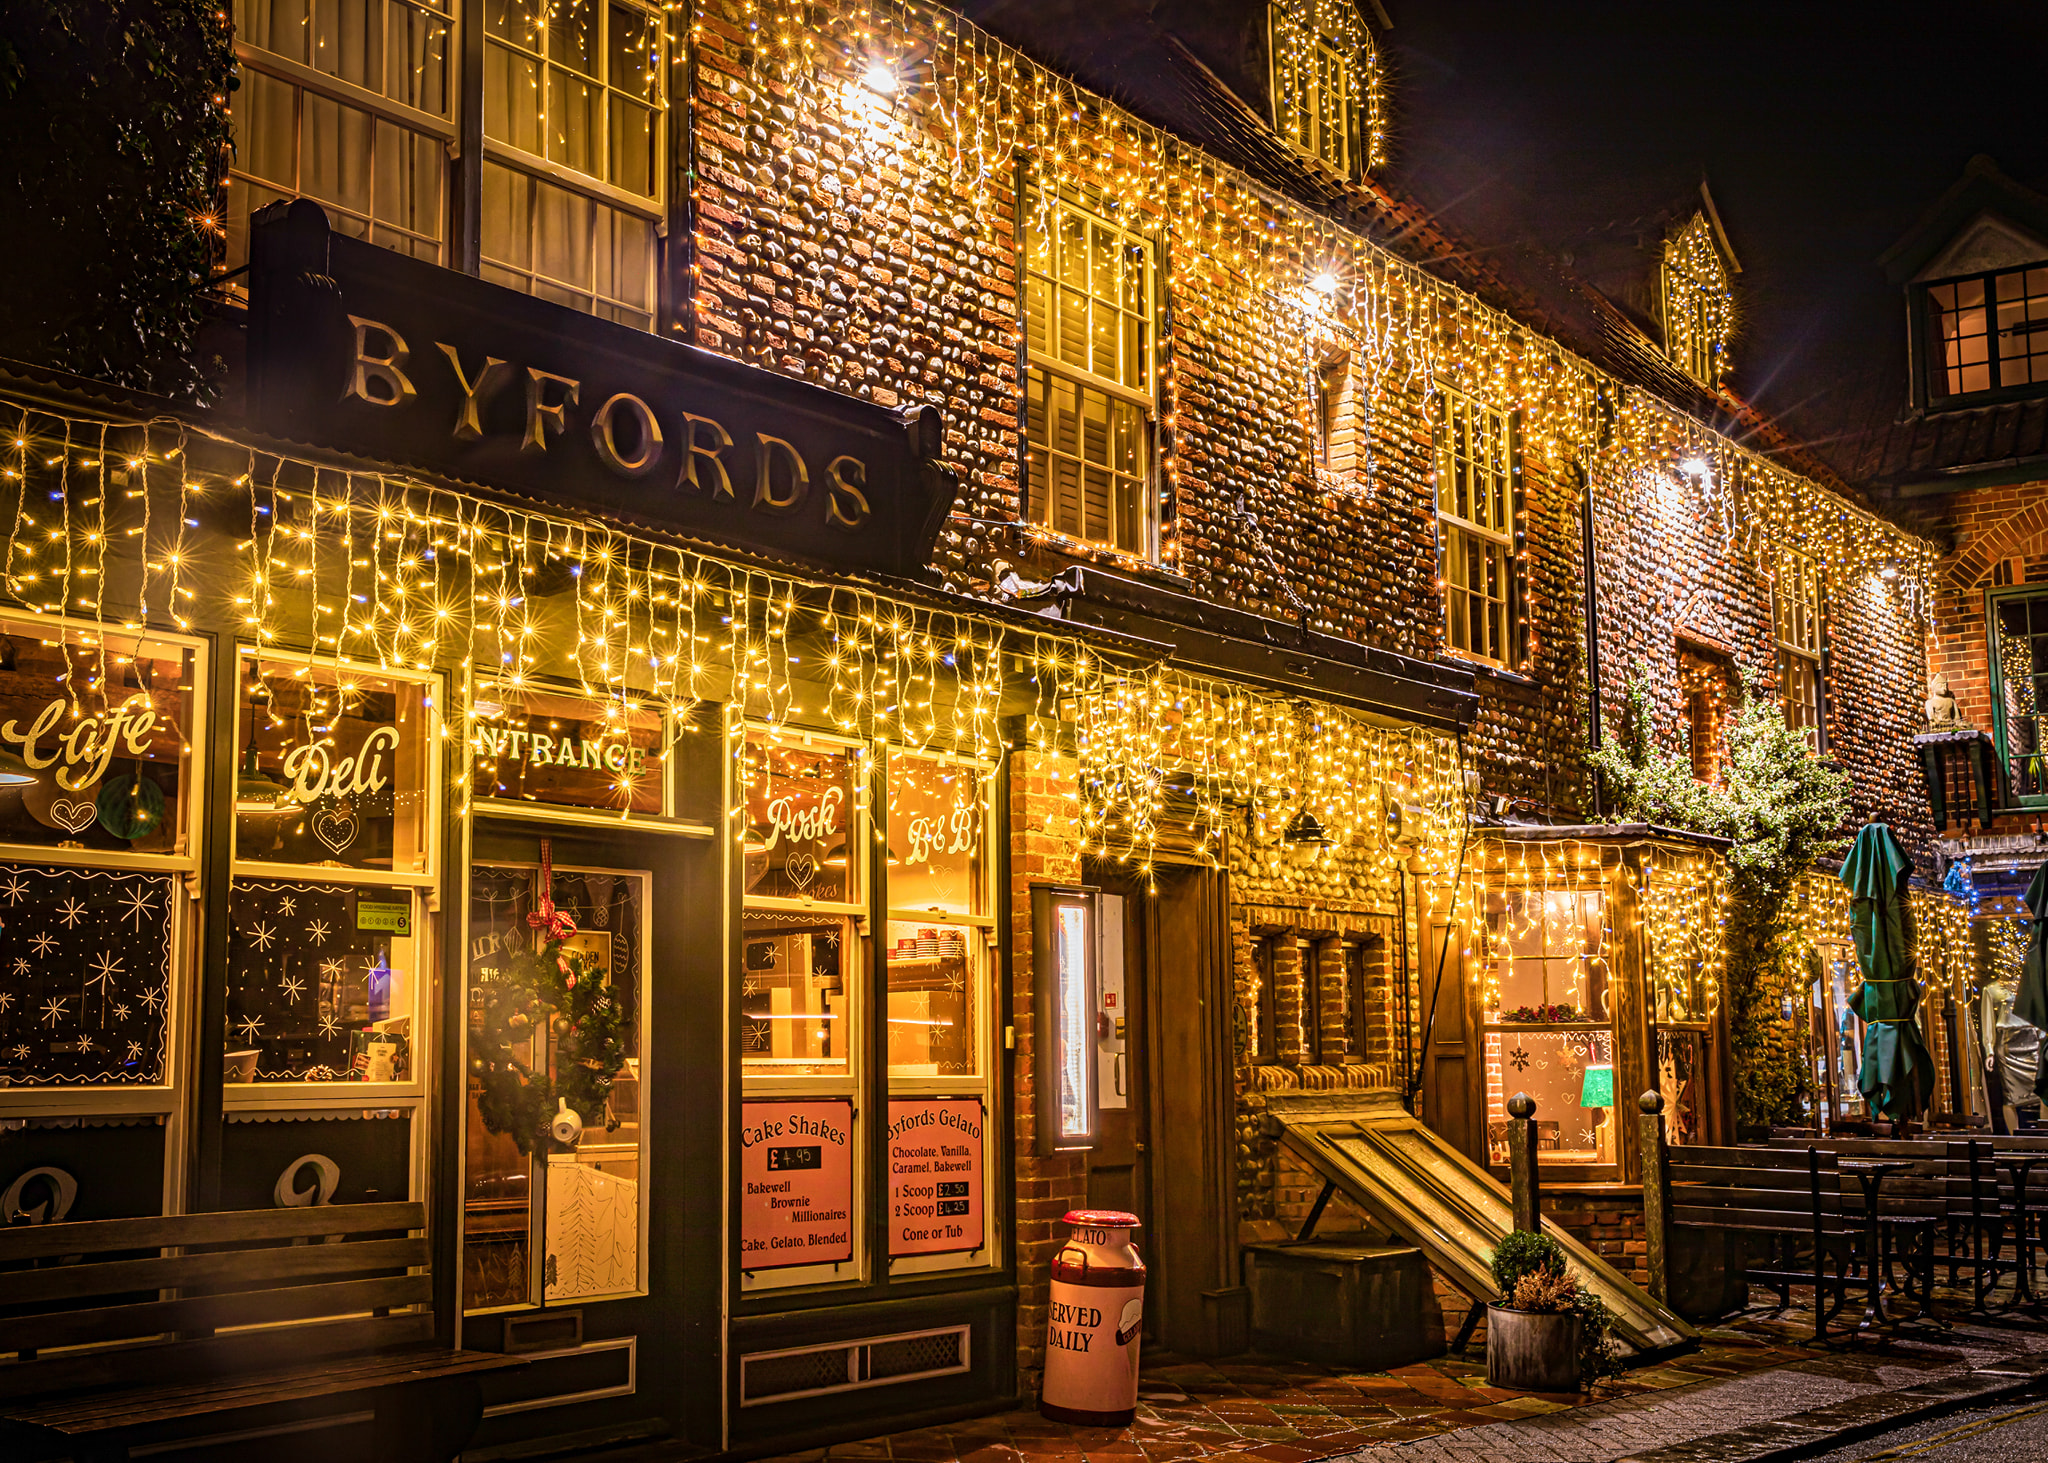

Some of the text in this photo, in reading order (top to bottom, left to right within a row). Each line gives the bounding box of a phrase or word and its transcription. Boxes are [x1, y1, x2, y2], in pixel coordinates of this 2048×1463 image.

[342, 313, 871, 528] BYFORDS
[1, 693, 156, 792] Cafe
[474, 726, 647, 776] NTRANCE
[274, 726, 400, 809] Deli
[764, 786, 843, 851] Posh
[742, 1114, 846, 1148] Cake Shakes
[939, 1108, 980, 1139] Gelato
[934, 1160, 972, 1172] Bakewell
[747, 1181, 791, 1194] Bakewell
[895, 1187, 899, 1198] 1
[902, 1184, 934, 1199] Scoop
[771, 1195, 811, 1209] Brownie
[895, 1205, 901, 1217] 2
[903, 1203, 935, 1218] Scoop
[791, 1209, 847, 1223] Millionaires
[902, 1224, 963, 1241] Cone or Tub
[1071, 1226, 1107, 1246] ELATO
[741, 1239, 768, 1252] Cake,
[770, 1236, 806, 1249] Gelato,
[1049, 1326, 1094, 1352] DAILY
